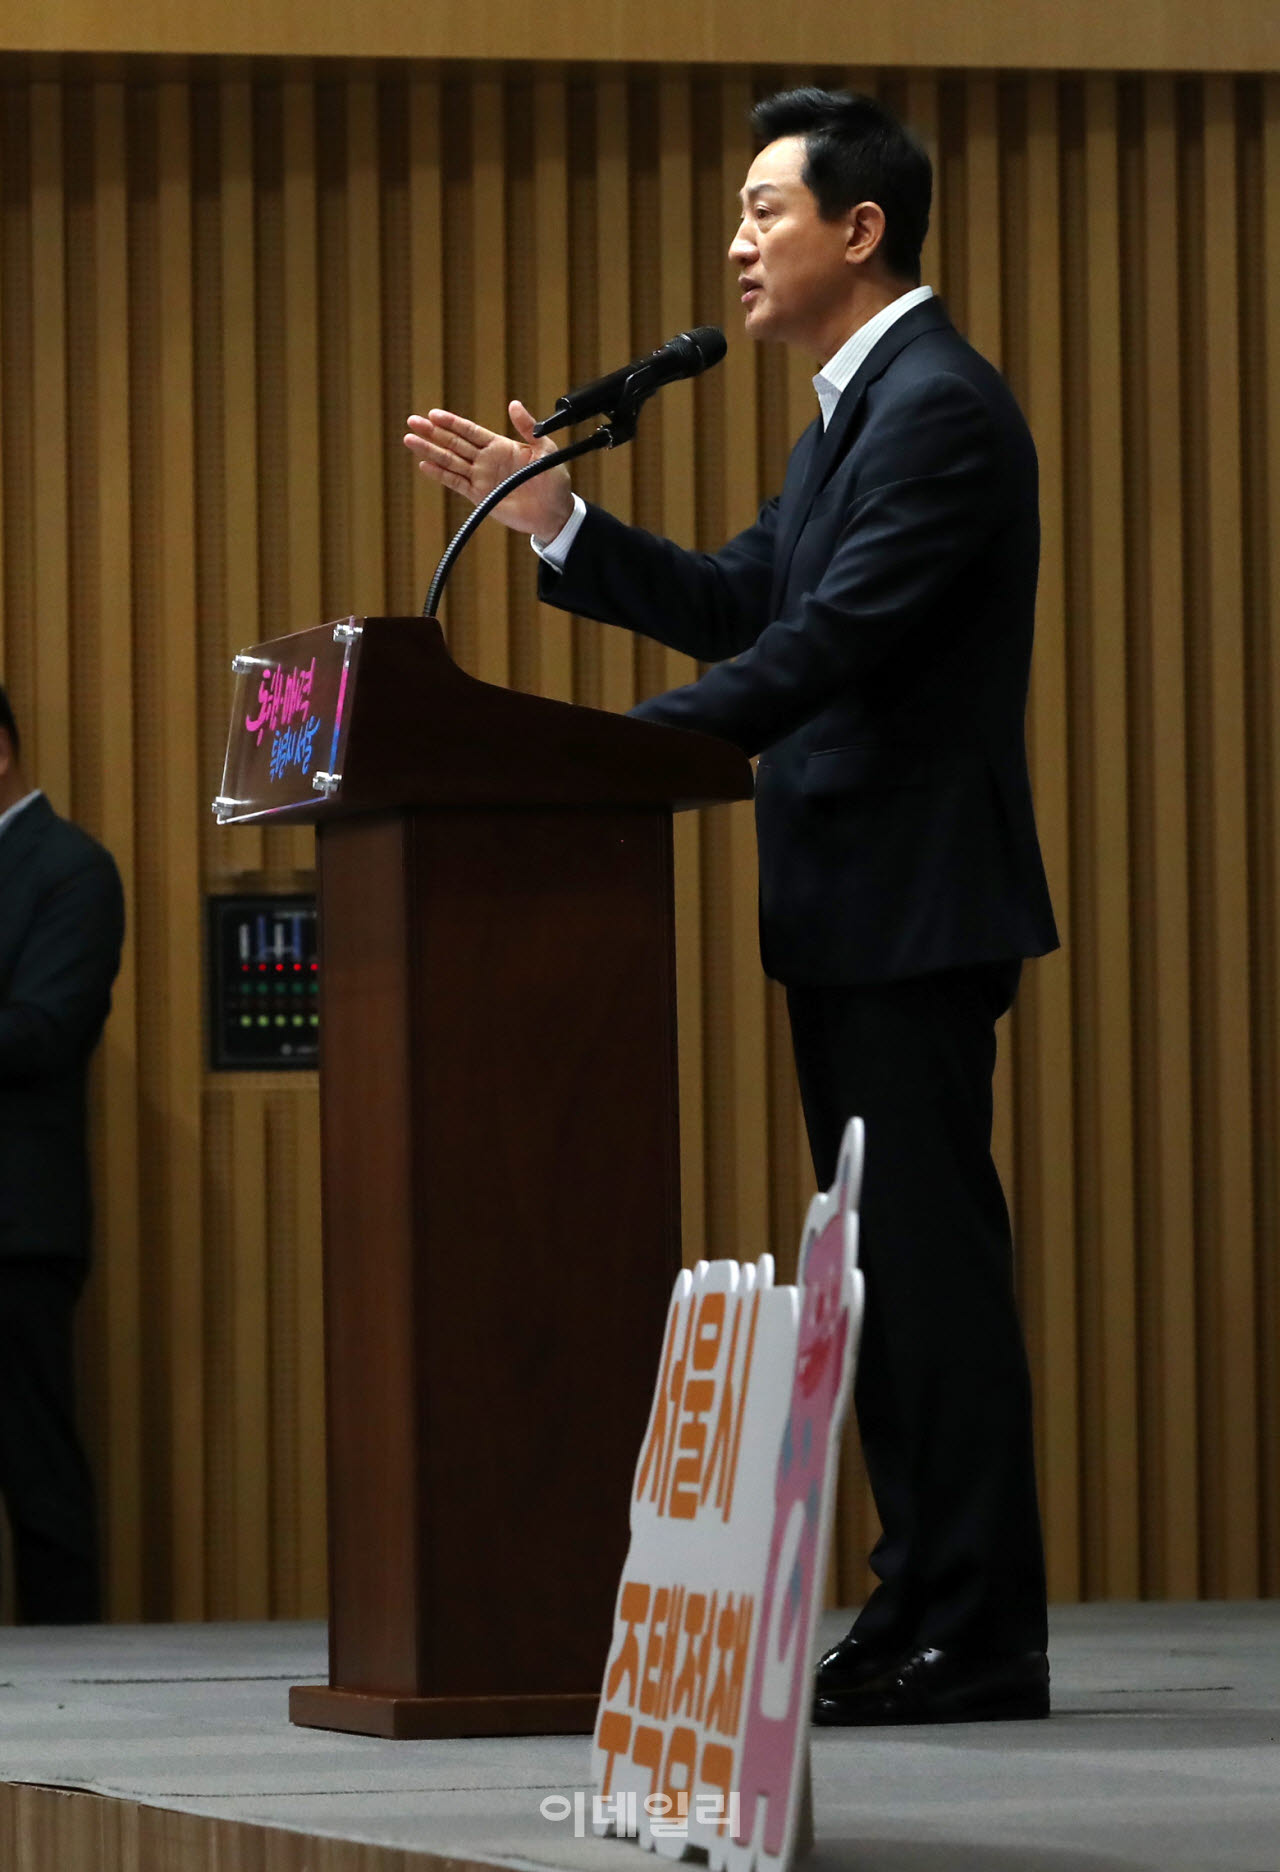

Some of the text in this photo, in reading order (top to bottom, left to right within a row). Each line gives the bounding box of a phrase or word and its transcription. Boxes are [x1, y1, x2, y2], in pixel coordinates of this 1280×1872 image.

[269, 715, 321, 784] 특별시 서울
[636, 1288, 760, 1524] 서울시
[597, 1581, 754, 1838] 주택정책
